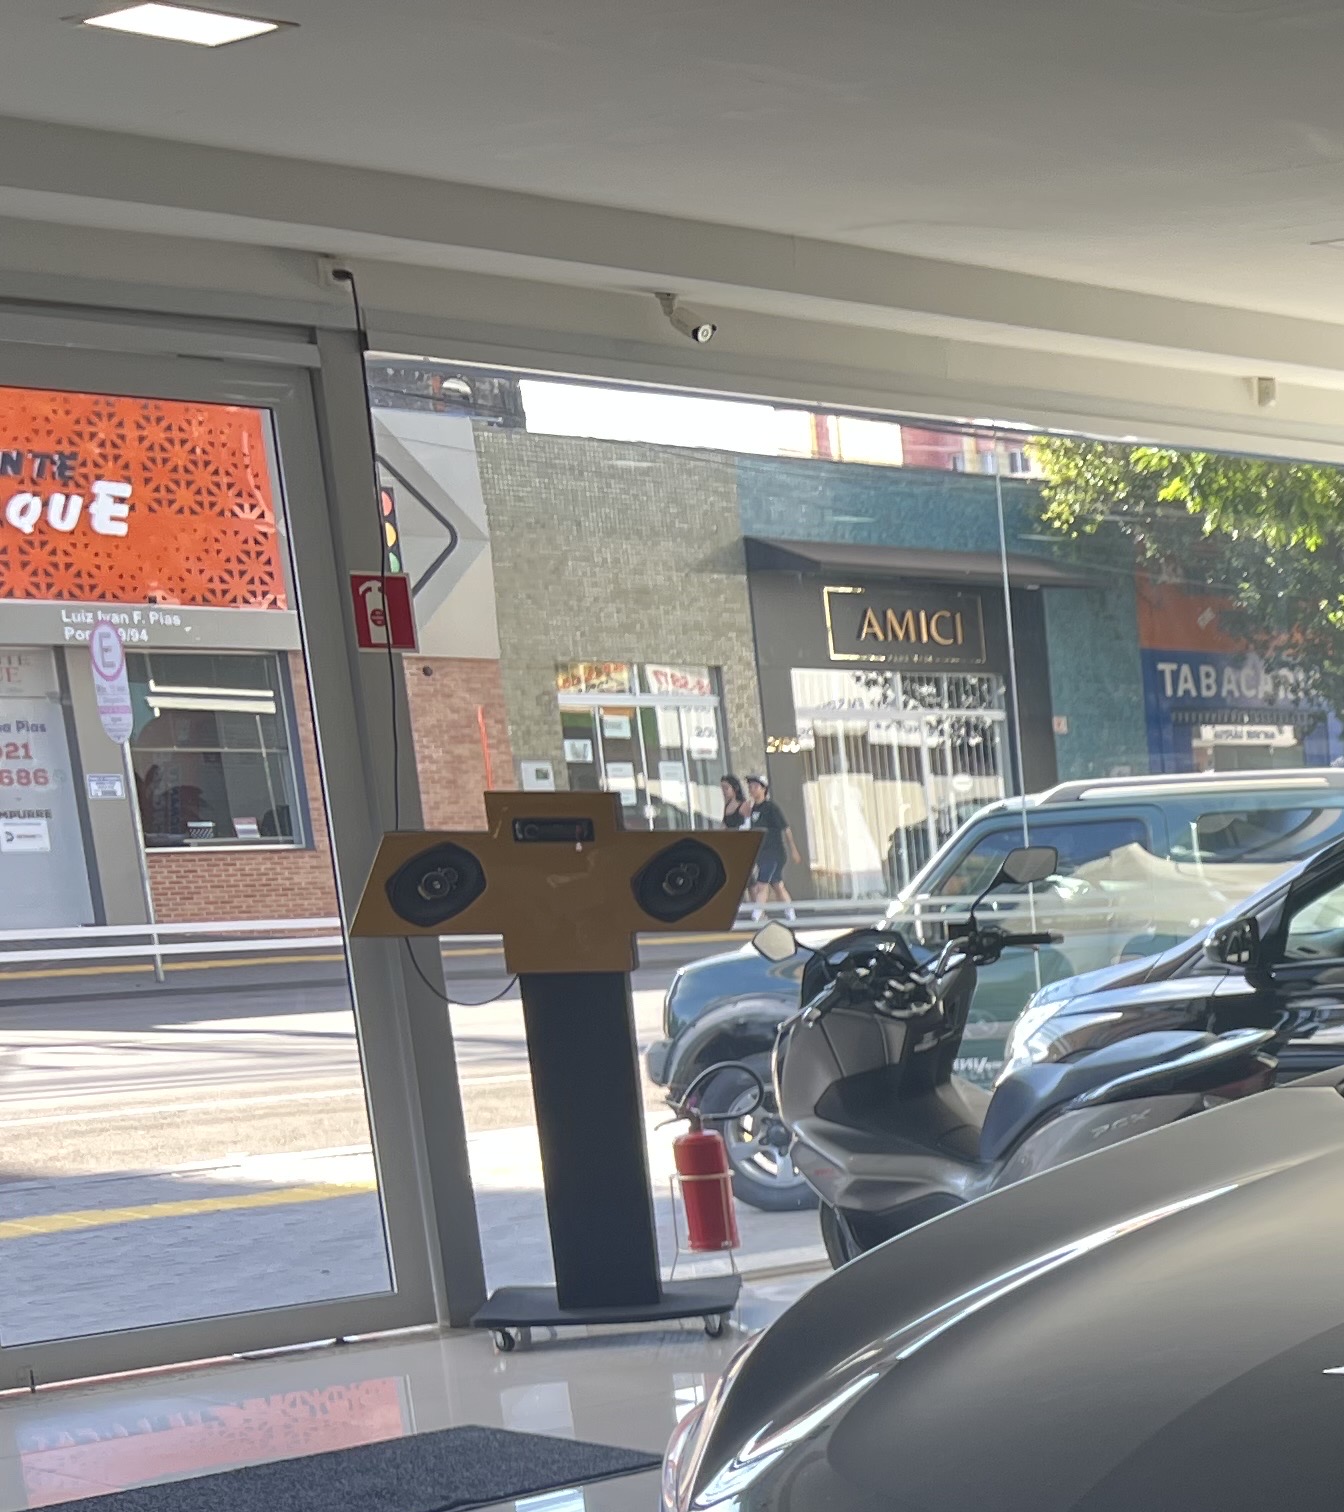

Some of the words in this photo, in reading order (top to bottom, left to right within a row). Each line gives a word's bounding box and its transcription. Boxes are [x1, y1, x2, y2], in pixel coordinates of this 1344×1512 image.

[5, 479, 133, 538] QUE
[61, 609, 94, 623] Luiz
[860, 606, 964, 646] AMICI
[98, 631, 116, 668] E
[0, 741, 33, 760] 21
